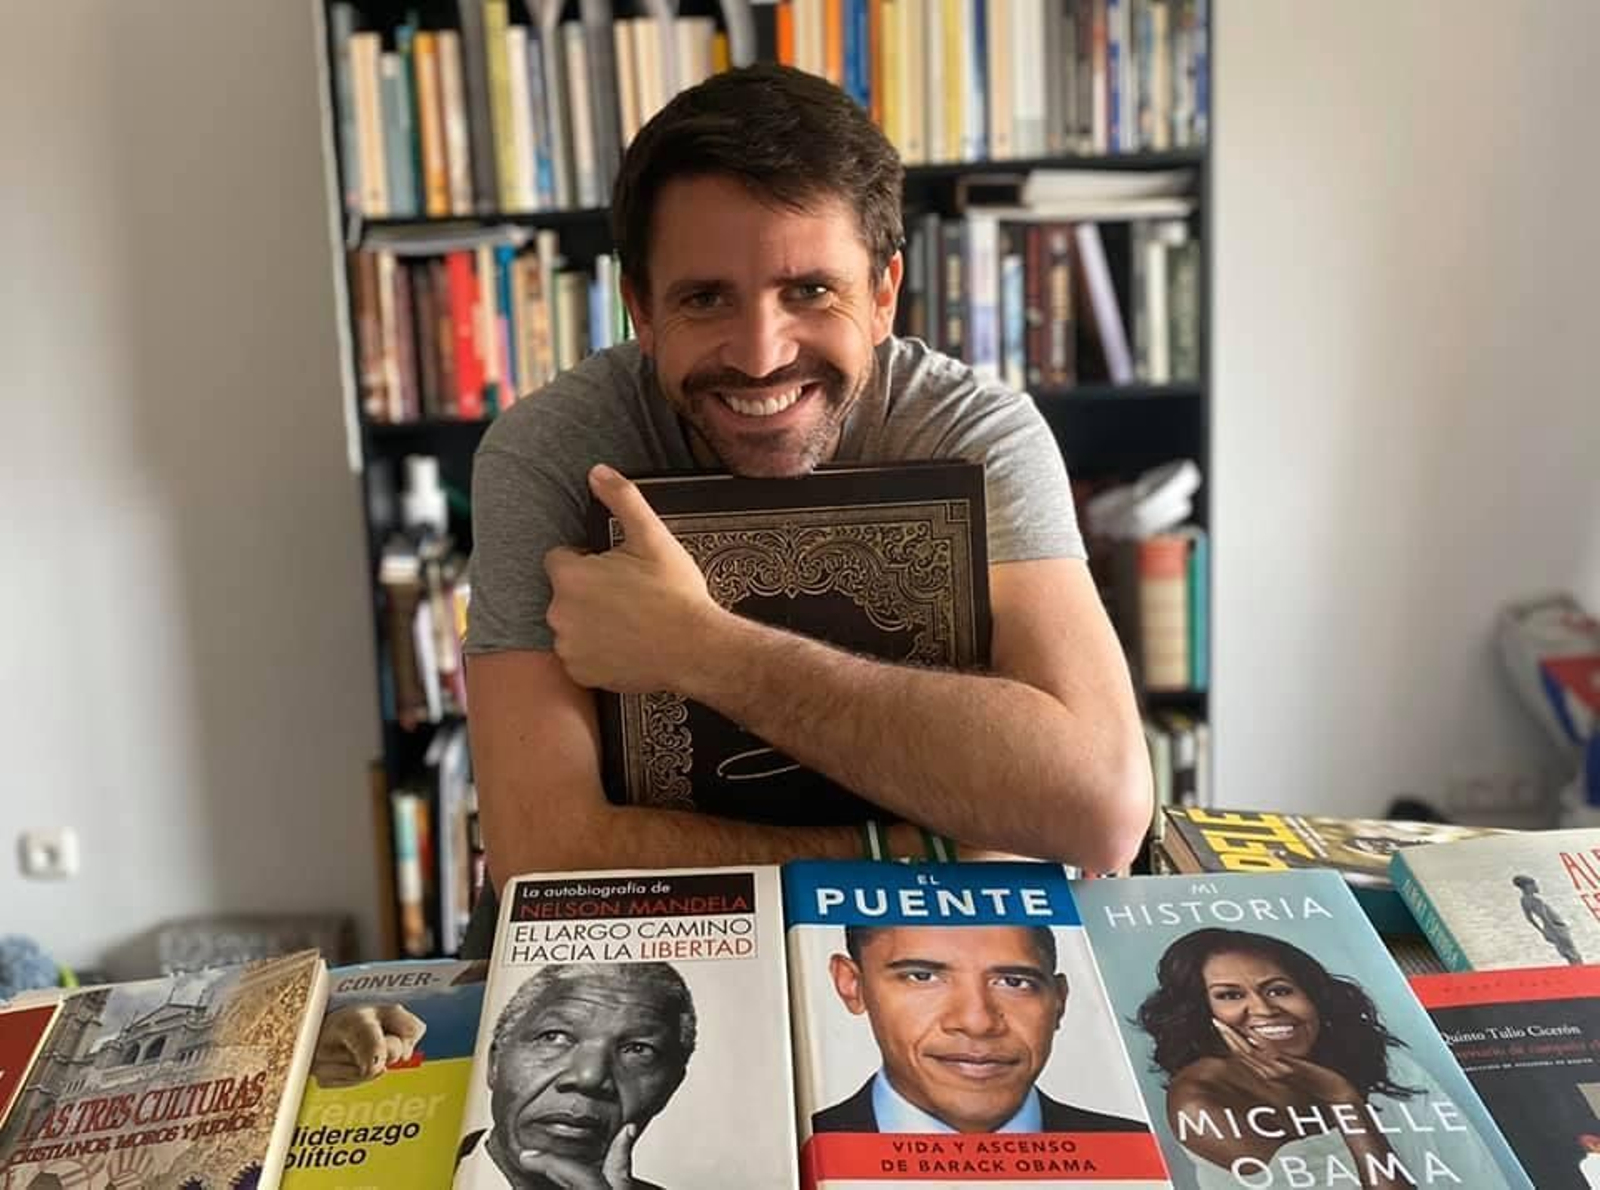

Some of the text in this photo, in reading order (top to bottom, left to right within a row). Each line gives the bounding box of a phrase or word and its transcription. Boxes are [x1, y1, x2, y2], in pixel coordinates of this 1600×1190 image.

[522, 886, 539, 898] La
[650, 881, 671, 893] de
[917, 874, 940, 884] EL
[1191, 882, 1218, 894] MI
[520, 894, 747, 918] NELSON MANDELA
[816, 888, 1053, 917] PUENTE
[1104, 896, 1333, 927] HISTORIA
[514, 918, 752, 942] EL LARGO CAMINO
[511, 938, 753, 962] HACIA LA LIBERTAD
[337, 972, 441, 993] CONVER-
[1487, 1026, 1526, 1041] Tulio
[16, 1071, 266, 1143] LAS TRES CULTURAS
[303, 1091, 447, 1126] render
[1177, 1101, 1467, 1141] MICHELLE
[290, 1122, 421, 1146] liderazgo
[284, 1146, 367, 1169] olítico
[892, 1140, 1077, 1153] VIDA Y ASCENSO
[881, 1159, 1097, 1172] DE BARACK OBAMA
[1231, 1151, 1462, 1190] OBAMA
